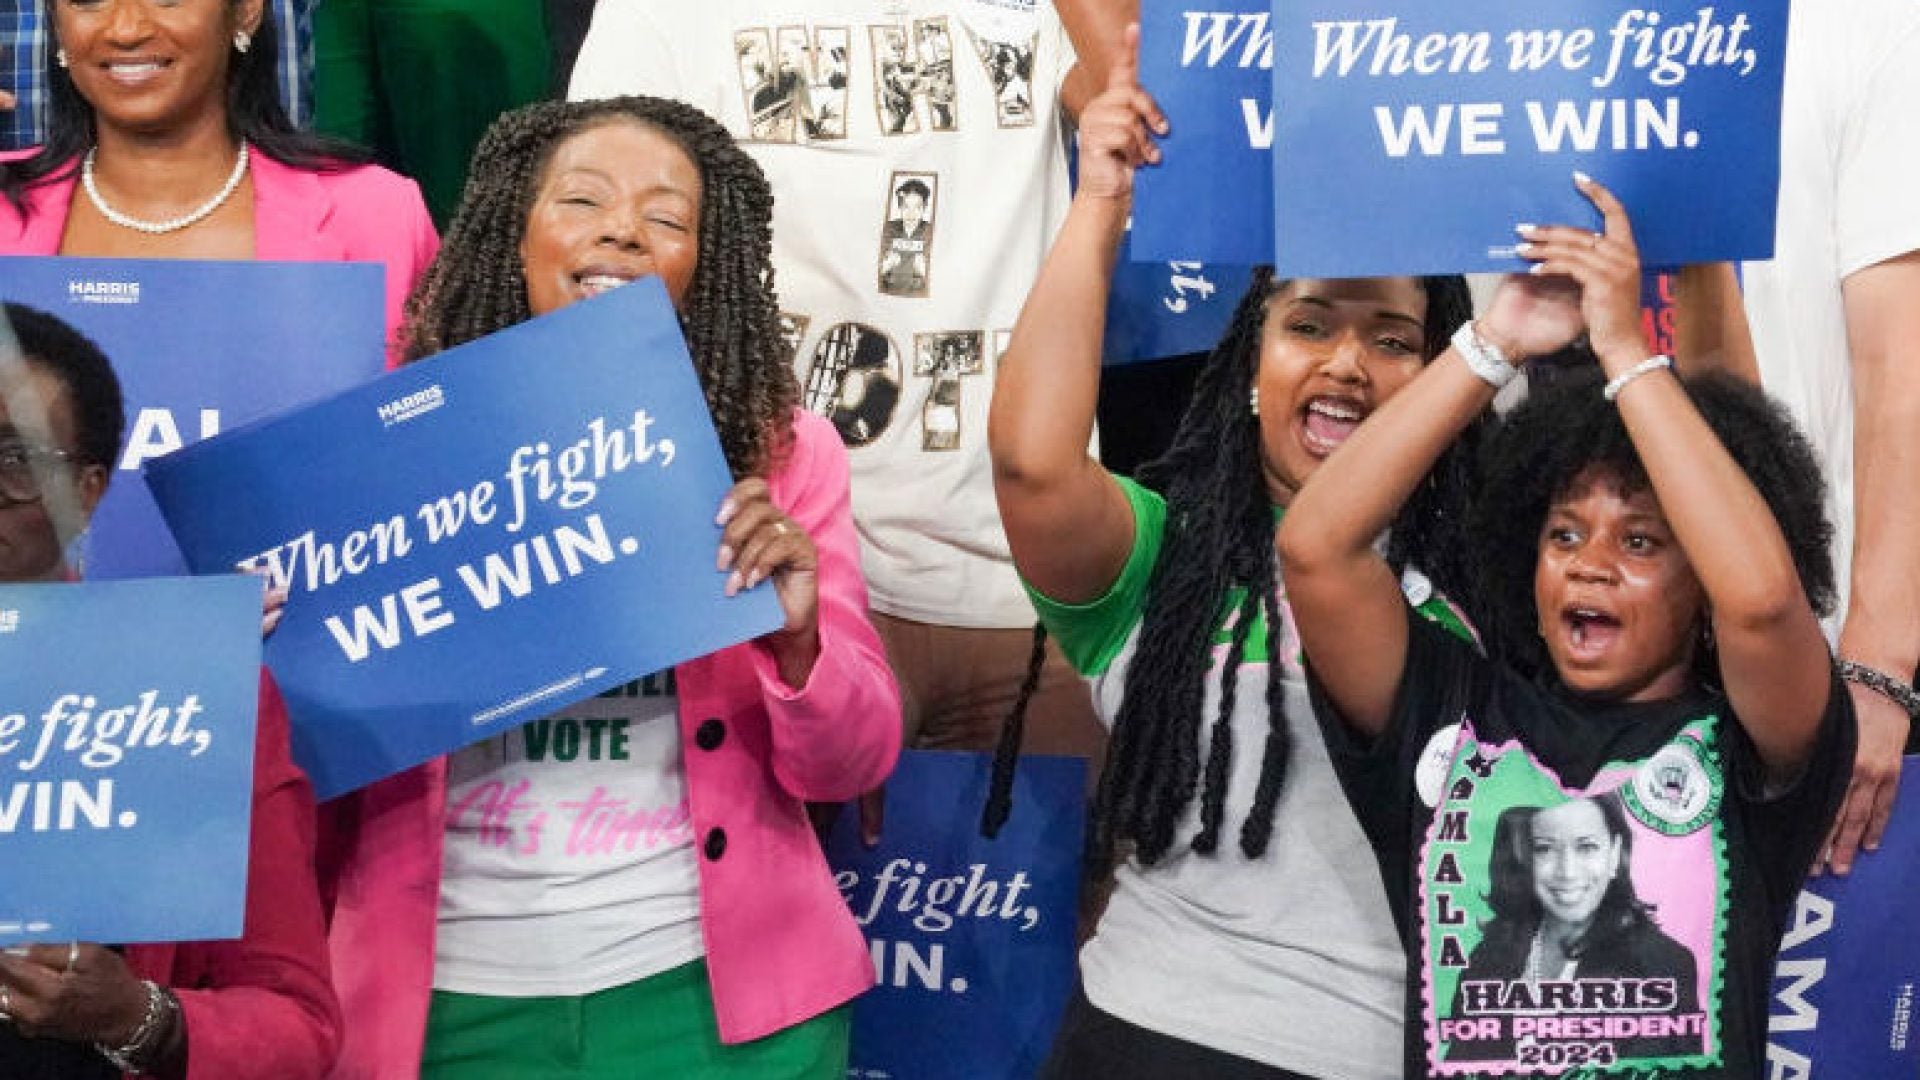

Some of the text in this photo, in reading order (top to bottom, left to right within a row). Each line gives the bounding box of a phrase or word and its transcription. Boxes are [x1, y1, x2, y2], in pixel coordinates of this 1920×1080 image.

[1311, 7, 1757, 88] When we fight,
[1374, 97, 1699, 157] WE WIN.
[70, 282, 140, 294] HARRIS
[377, 385, 444, 420] HARRIS
[235, 409, 676, 592] When we fight,
[324, 513, 639, 663] WE WIN.
[18, 689, 211, 771] fight,
[521, 718, 630, 761] VOTE
[856, 858, 1040, 932] fight,
[1462, 978, 1678, 1014] HARRIS
[1439, 1012, 1707, 1041] FOR PRESIDENT
[1517, 1042, 1617, 1067] 2024
